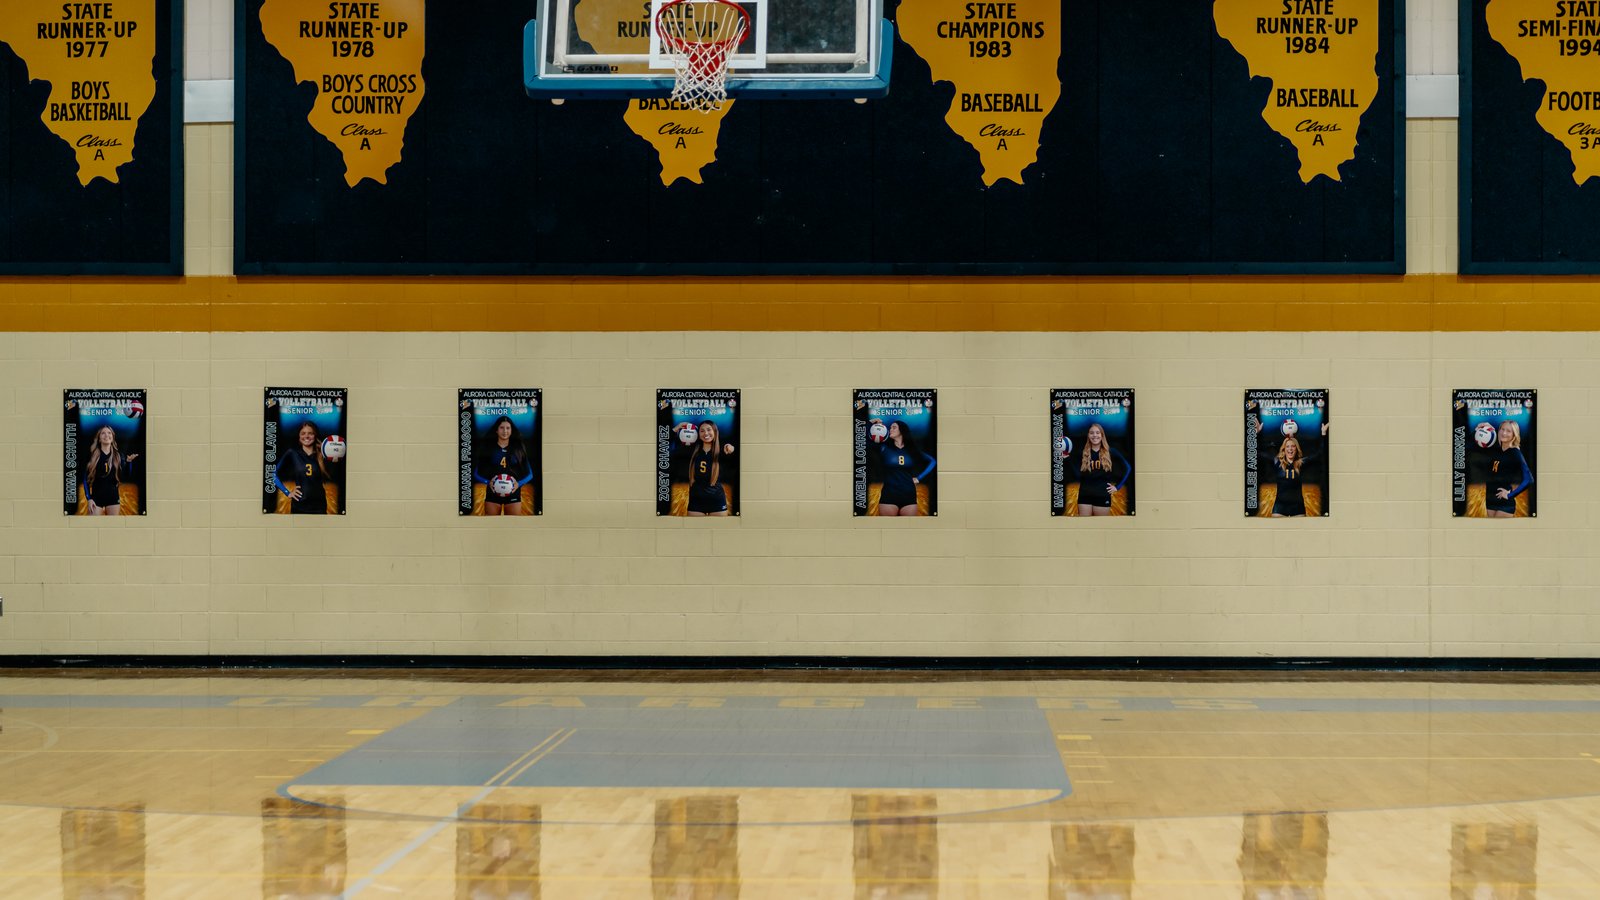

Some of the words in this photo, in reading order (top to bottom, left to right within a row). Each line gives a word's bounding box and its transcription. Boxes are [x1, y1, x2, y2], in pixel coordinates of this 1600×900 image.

[62, 3, 113, 19] STATE
[328, 2, 379, 19] STATE
[643, 2, 694, 18] SATE
[965, 2, 1016, 19] STATE
[1282, 0, 1334, 15] STATE
[1556, 1, 1600, 17] STAT
[37, 21, 137, 39] RUNNER-UP
[299, 21, 408, 39] RUNNER-UP
[618, 21, 718, 37] RUNER-UP
[936, 22, 1045, 39] CHAMPIONS
[1256, 18, 1359, 35] RUNNER-UP
[66, 41, 109, 58] 1977
[332, 41, 374, 58] 1978
[969, 41, 1012, 58] 1983
[1285, 37, 1330, 54] 1984
[1559, 39, 1600, 56] 1994
[71, 81, 110, 100] BOYS
[322, 74, 365, 93] BOYS
[368, 74, 417, 93] CROSS
[331, 95, 405, 115] COUNTRY
[960, 93, 1043, 113] BASEBALL
[1276, 89, 1359, 108] BASEBALL
[50, 102, 131, 121] BASKETBALL
[340, 123, 387, 138] Class
[658, 122, 703, 135] Class
[979, 124, 1025, 139] Class
[1295, 119, 1342, 133] Class
[76, 134, 122, 148] Class
[360, 138, 371, 151] A
[675, 137, 686, 149] A
[996, 138, 1008, 150] A
[1312, 134, 1324, 146] A
[94, 149, 105, 161] A
[78, 399, 133, 408] VOLLEYBALL
[278, 397, 333, 407] VOLLEYBALL
[472, 399, 528, 408] VOLLEYBALL
[671, 399, 726, 408] VOLLEYBALL
[867, 399, 922, 408] VOLLEYBALL
[1064, 399, 1120, 408] VOLLEYBALL
[1259, 399, 1314, 408] VOLLEYBALL
[1467, 399, 1522, 408] VOLLEYBALL
[66, 423, 77, 468] SCHUTH
[266, 421, 277, 462] GLAVIN
[659, 425, 670, 470] CHAVEZ
[855, 419, 866, 465] LOHREY
[1247, 413, 1257, 470] ANDERSON
[1454, 426, 1465, 469] BRINKA
[500, 456, 507, 468] 4
[899, 456, 905, 465] 8
[1090, 460, 1101, 470] 10
[305, 464, 312, 476] 3
[1286, 469, 1295, 479] 11
[66, 470, 77, 503] EMMA
[265, 464, 277, 494] CATE
[461, 462, 471, 509] ARIANNA
[659, 471, 670, 502] ZOEY
[856, 466, 866, 508] AMELIA
[1454, 471, 1465, 501] LILLY
[1054, 483, 1064, 508] MARY
